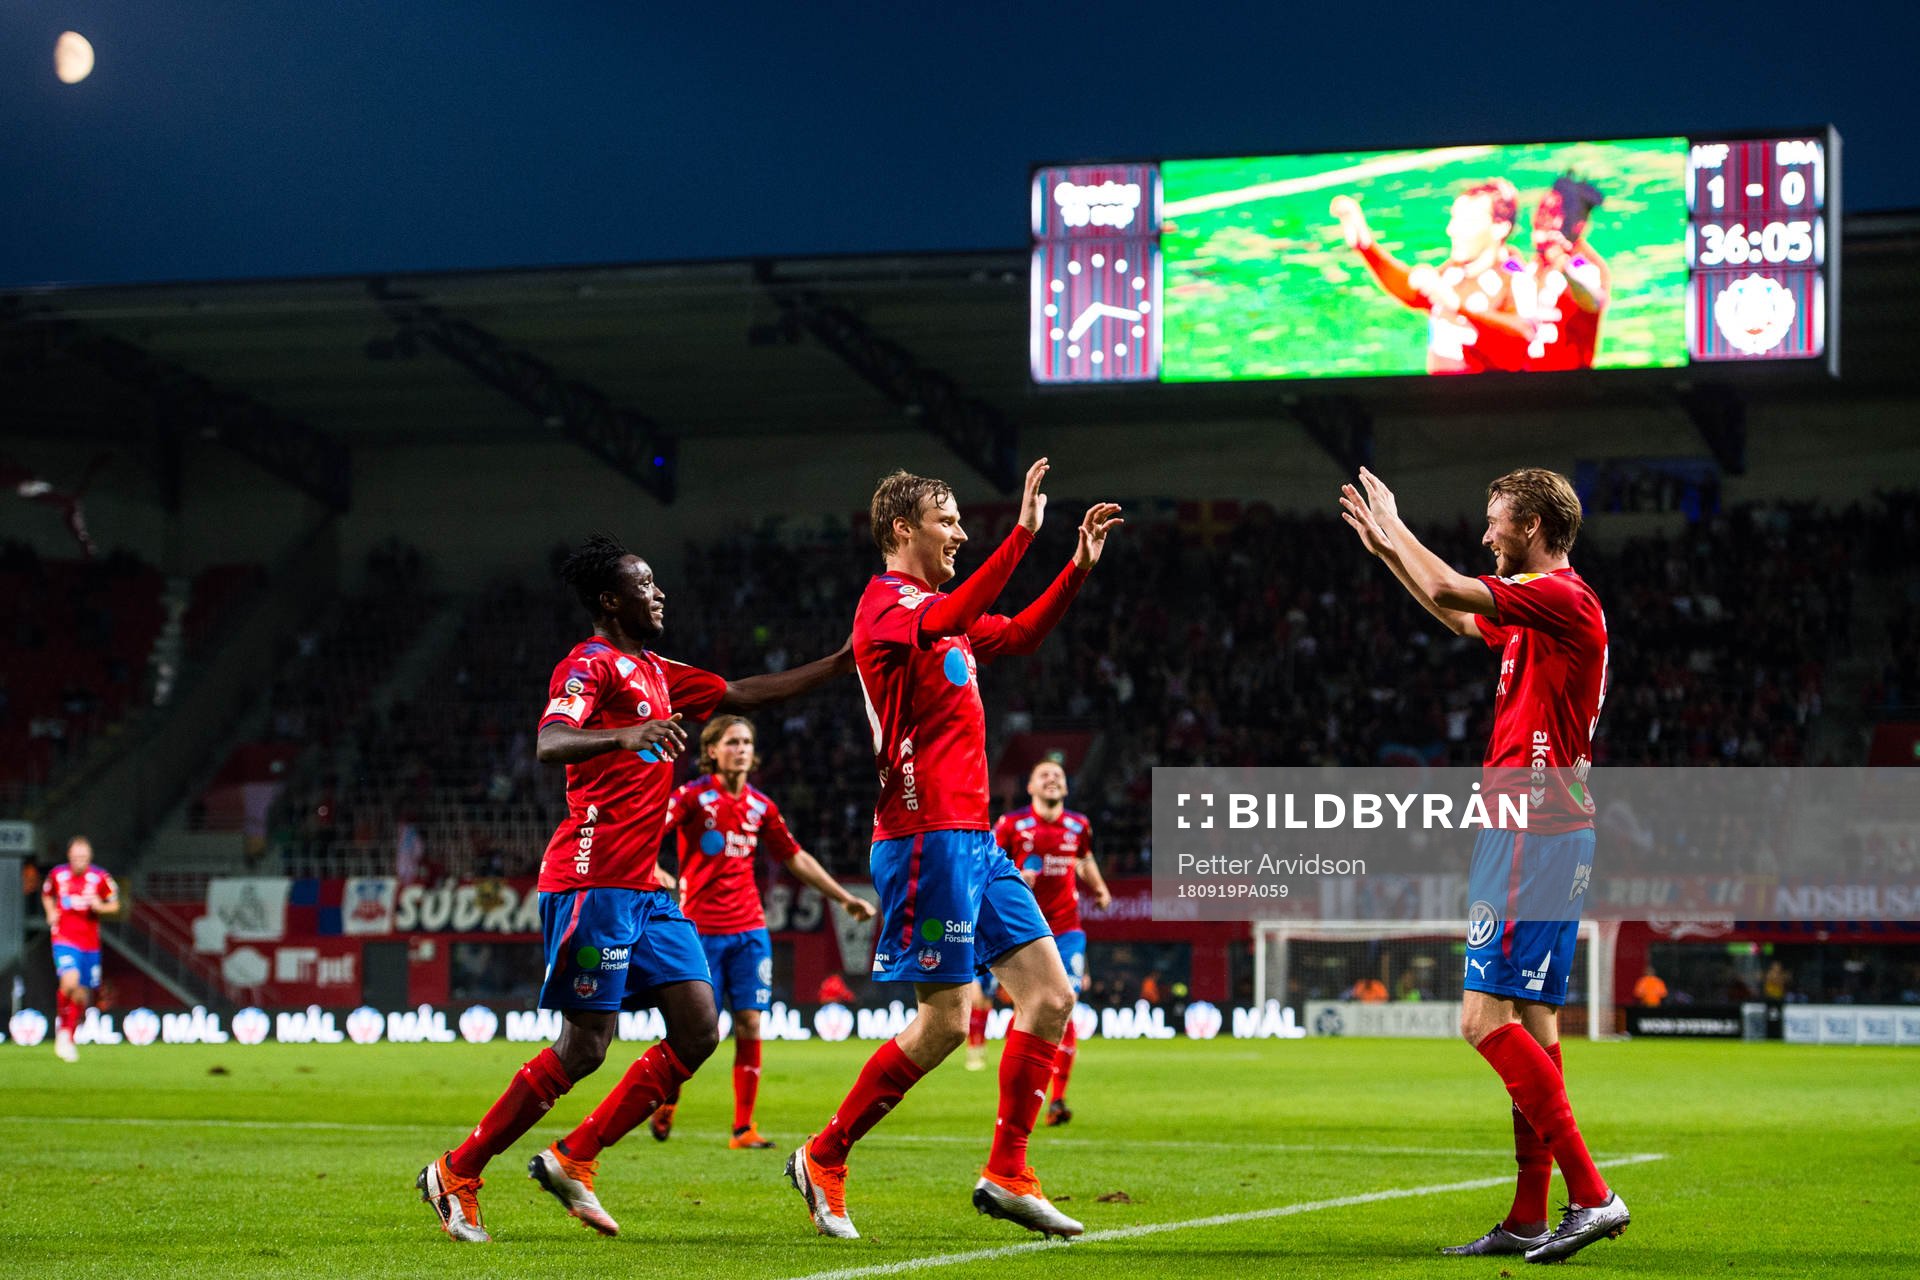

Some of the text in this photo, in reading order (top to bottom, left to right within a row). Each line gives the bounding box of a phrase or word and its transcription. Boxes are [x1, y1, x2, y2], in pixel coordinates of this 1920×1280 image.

[1706, 175, 1724, 208] 1
[1780, 171, 1806, 206] 0
[1700, 221, 1813, 265] 36:05
[1531, 730, 1550, 785] akea
[902, 762, 918, 811] akea
[574, 826, 595, 875] akea
[945, 919, 972, 933] Solid
[58, 1006, 123, 1044] ÅL
[162, 1005, 229, 1043] MÅL
[276, 1004, 344, 1043] MÅL
[387, 1003, 456, 1042] MÅL
[759, 1001, 811, 1040] ÅL
[1102, 999, 1176, 1039] MÅL
[1232, 998, 1306, 1039] MÅL
